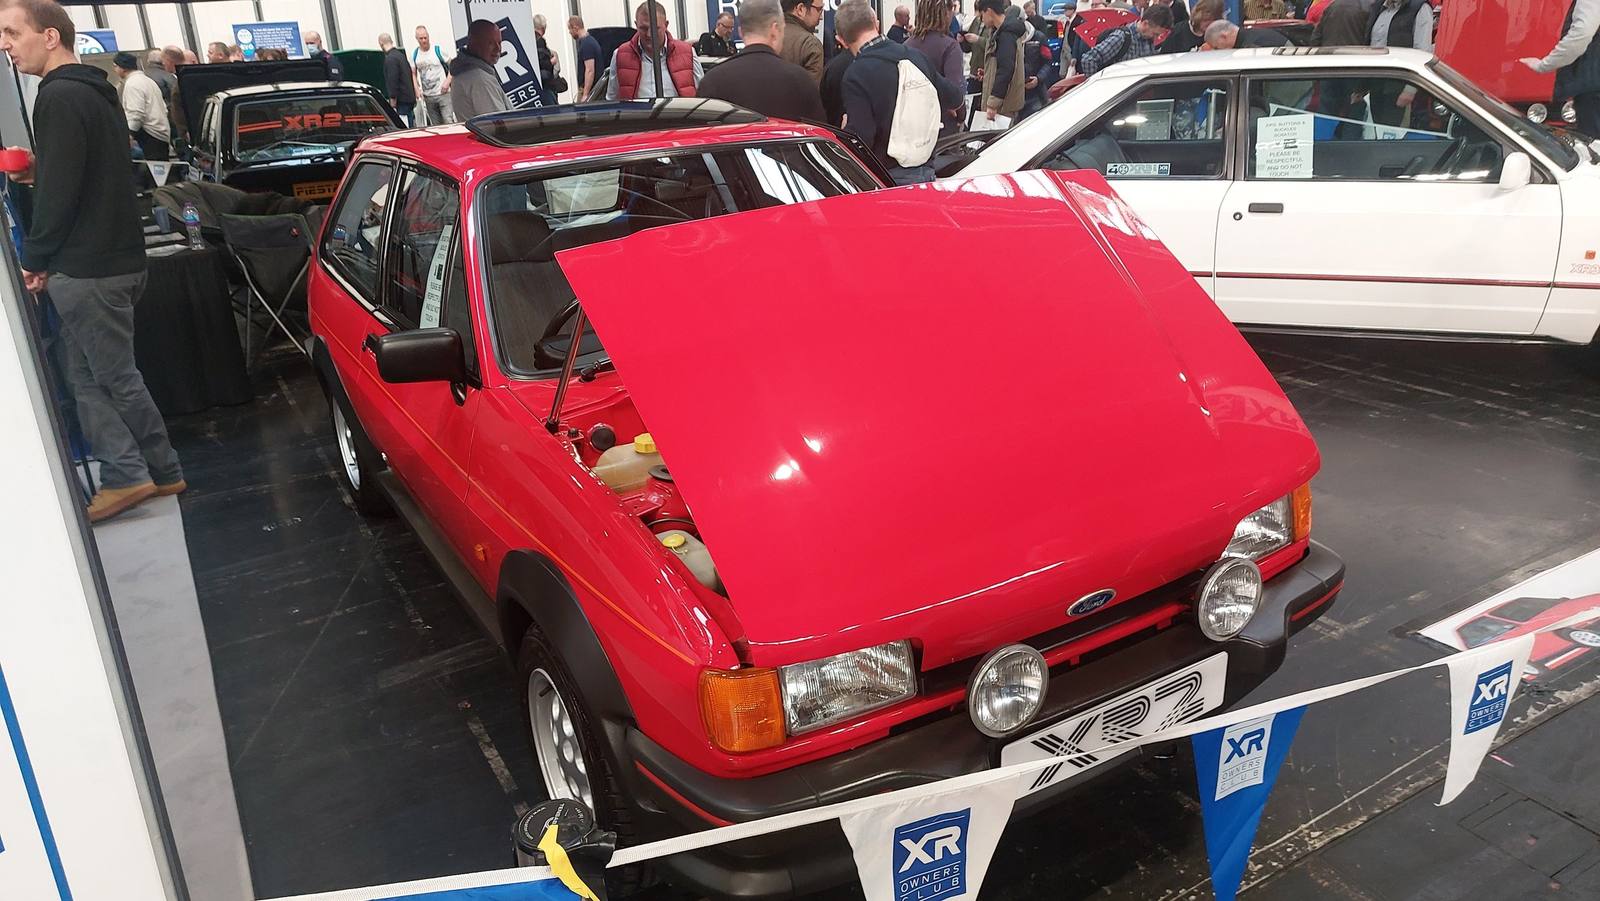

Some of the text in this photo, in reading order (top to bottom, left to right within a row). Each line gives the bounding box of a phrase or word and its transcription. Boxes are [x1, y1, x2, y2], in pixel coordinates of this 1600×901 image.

[509, 86, 536, 105] ERS
[283, 112, 343, 129] XR2
[1079, 595, 1107, 613] Ford
[1473, 673, 1509, 705] XR
[1469, 710, 1503, 727] CLUB
[1471, 702, 1504, 718] OWNERS
[1224, 727, 1265, 764] XR
[1221, 769, 1259, 790] CLUB
[1222, 760, 1260, 780] OWNERS
[898, 825, 961, 874] XR
[900, 864, 960, 893] OWNERS
